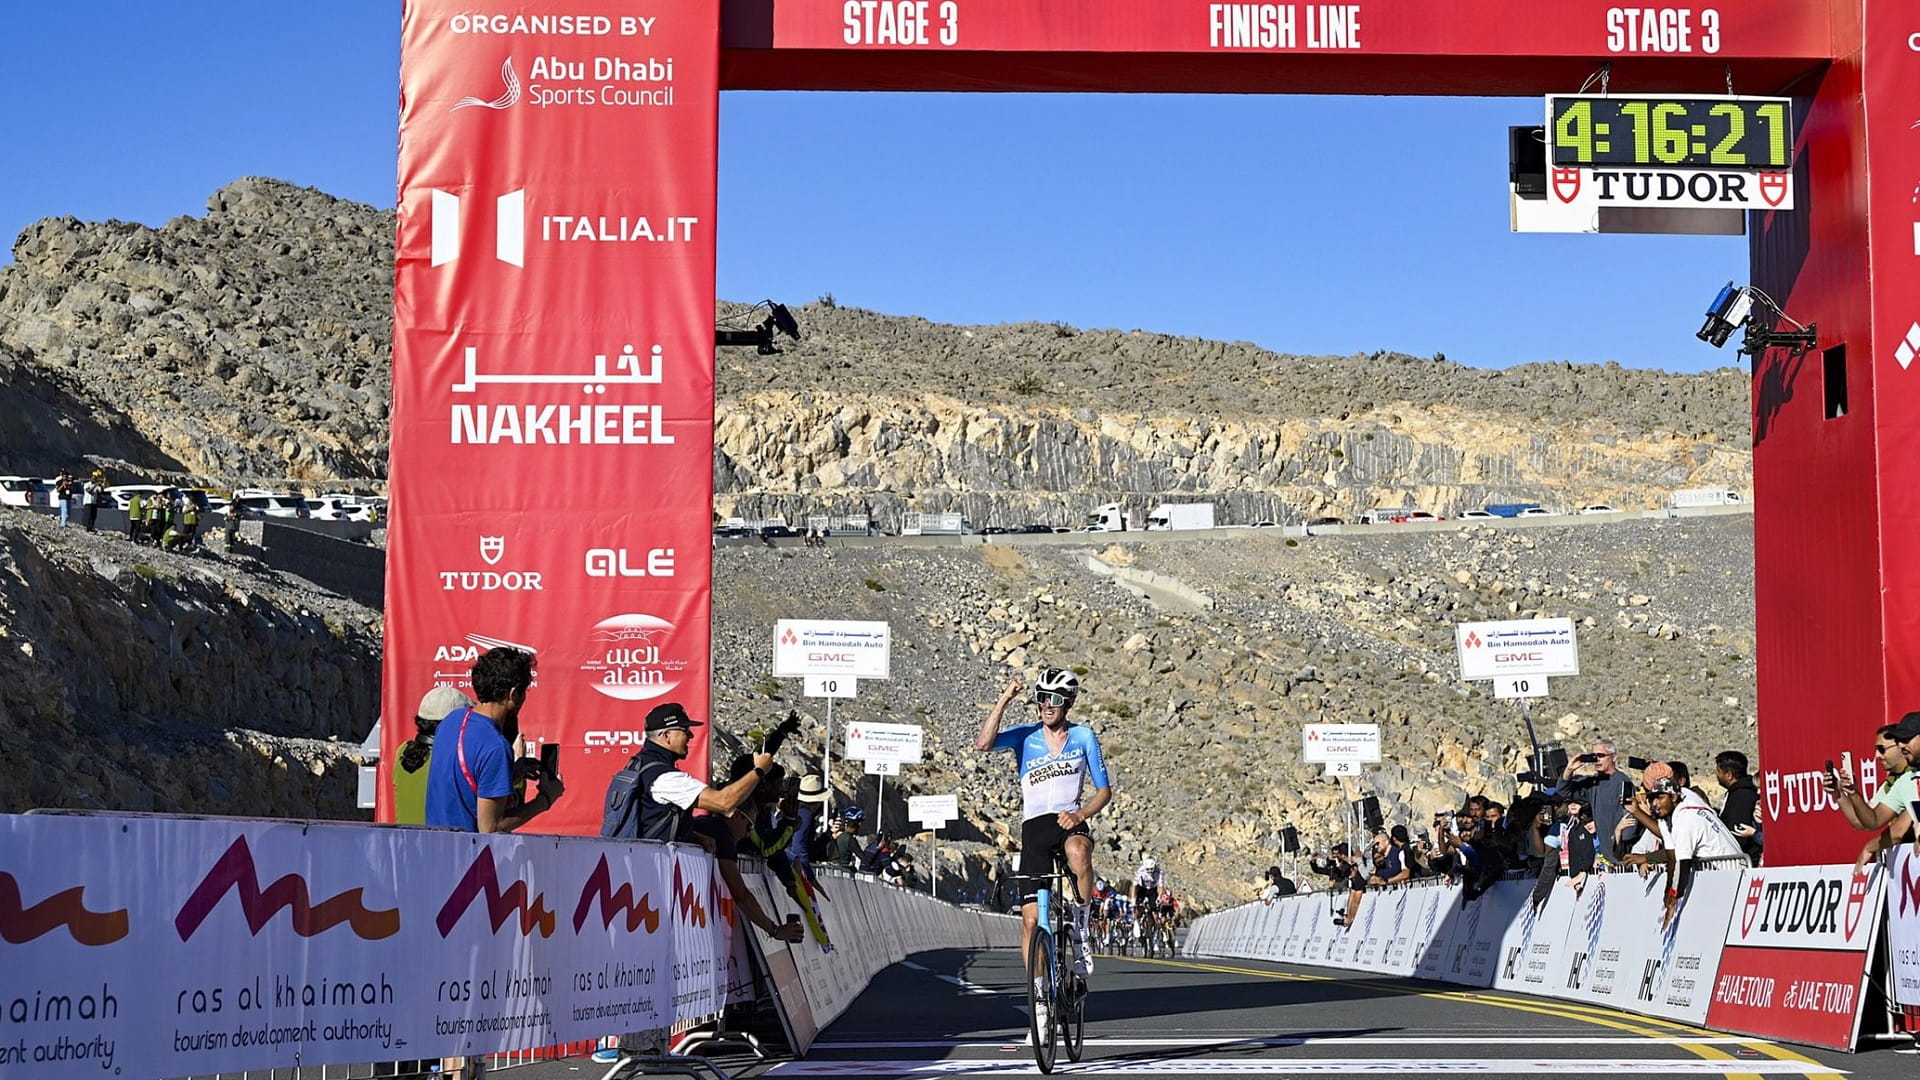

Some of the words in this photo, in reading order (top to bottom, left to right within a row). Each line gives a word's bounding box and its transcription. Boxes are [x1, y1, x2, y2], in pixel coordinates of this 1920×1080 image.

[450, 15, 611, 35] ORGANISED
[620, 17, 656, 36] BY
[843, 1, 929, 45] STAGE
[939, 1, 958, 46] 3
[1209, 4, 1296, 48] FINISH
[1306, 5, 1361, 48] LINE
[1607, 8, 1691, 52] STAGE
[1701, 9, 1720, 53] 3
[529, 56, 584, 80] Abu
[594, 57, 673, 82] Dhabi
[529, 84, 596, 108] Sports
[600, 86, 673, 106] Council
[1556, 101, 1785, 165] 4:16:21
[1592, 172, 1748, 202] TUDOR
[543, 216, 698, 242] ITALIA.IT
[451, 405, 675, 444] NAKHEEL
[440, 571, 543, 591] TUDOR
[808, 653, 856, 662] GMC
[1495, 652, 1544, 662] GMC
[821, 680, 837, 693] 10
[1512, 680, 1529, 693] 10
[876, 763, 888, 772] 25
[1026, 747, 1083, 769] DECAHLON
[1028, 763, 1055, 780] AG2R
[1056, 761, 1073, 770] LA
[1337, 763, 1349, 772] 25
[1030, 767, 1080, 787] MONDIALE
[1783, 768, 1842, 813] TUDO
[1760, 878, 1843, 935] TUDOR
[437, 980, 471, 1002] ras
[481, 970, 497, 1000] al
[573, 972, 592, 992] ras
[597, 962, 608, 989] al
[614, 960, 656, 988] khaimah
[1716, 974, 1775, 1008] #UAETOUR
[0, 983, 117, 1023] aimah
[177, 987, 223, 1014] ras
[238, 976, 262, 1010] al
[275, 972, 393, 1008] khaimah
[1799, 980, 1823, 1012] UAE
[1822, 982, 1854, 1015] TOUR
[174, 1029, 227, 1052] tourism
[232, 1019, 317, 1052] development
[323, 1017, 392, 1049] authority
[436, 1015, 474, 1035] tourism
[33, 1033, 115, 1070] authority
